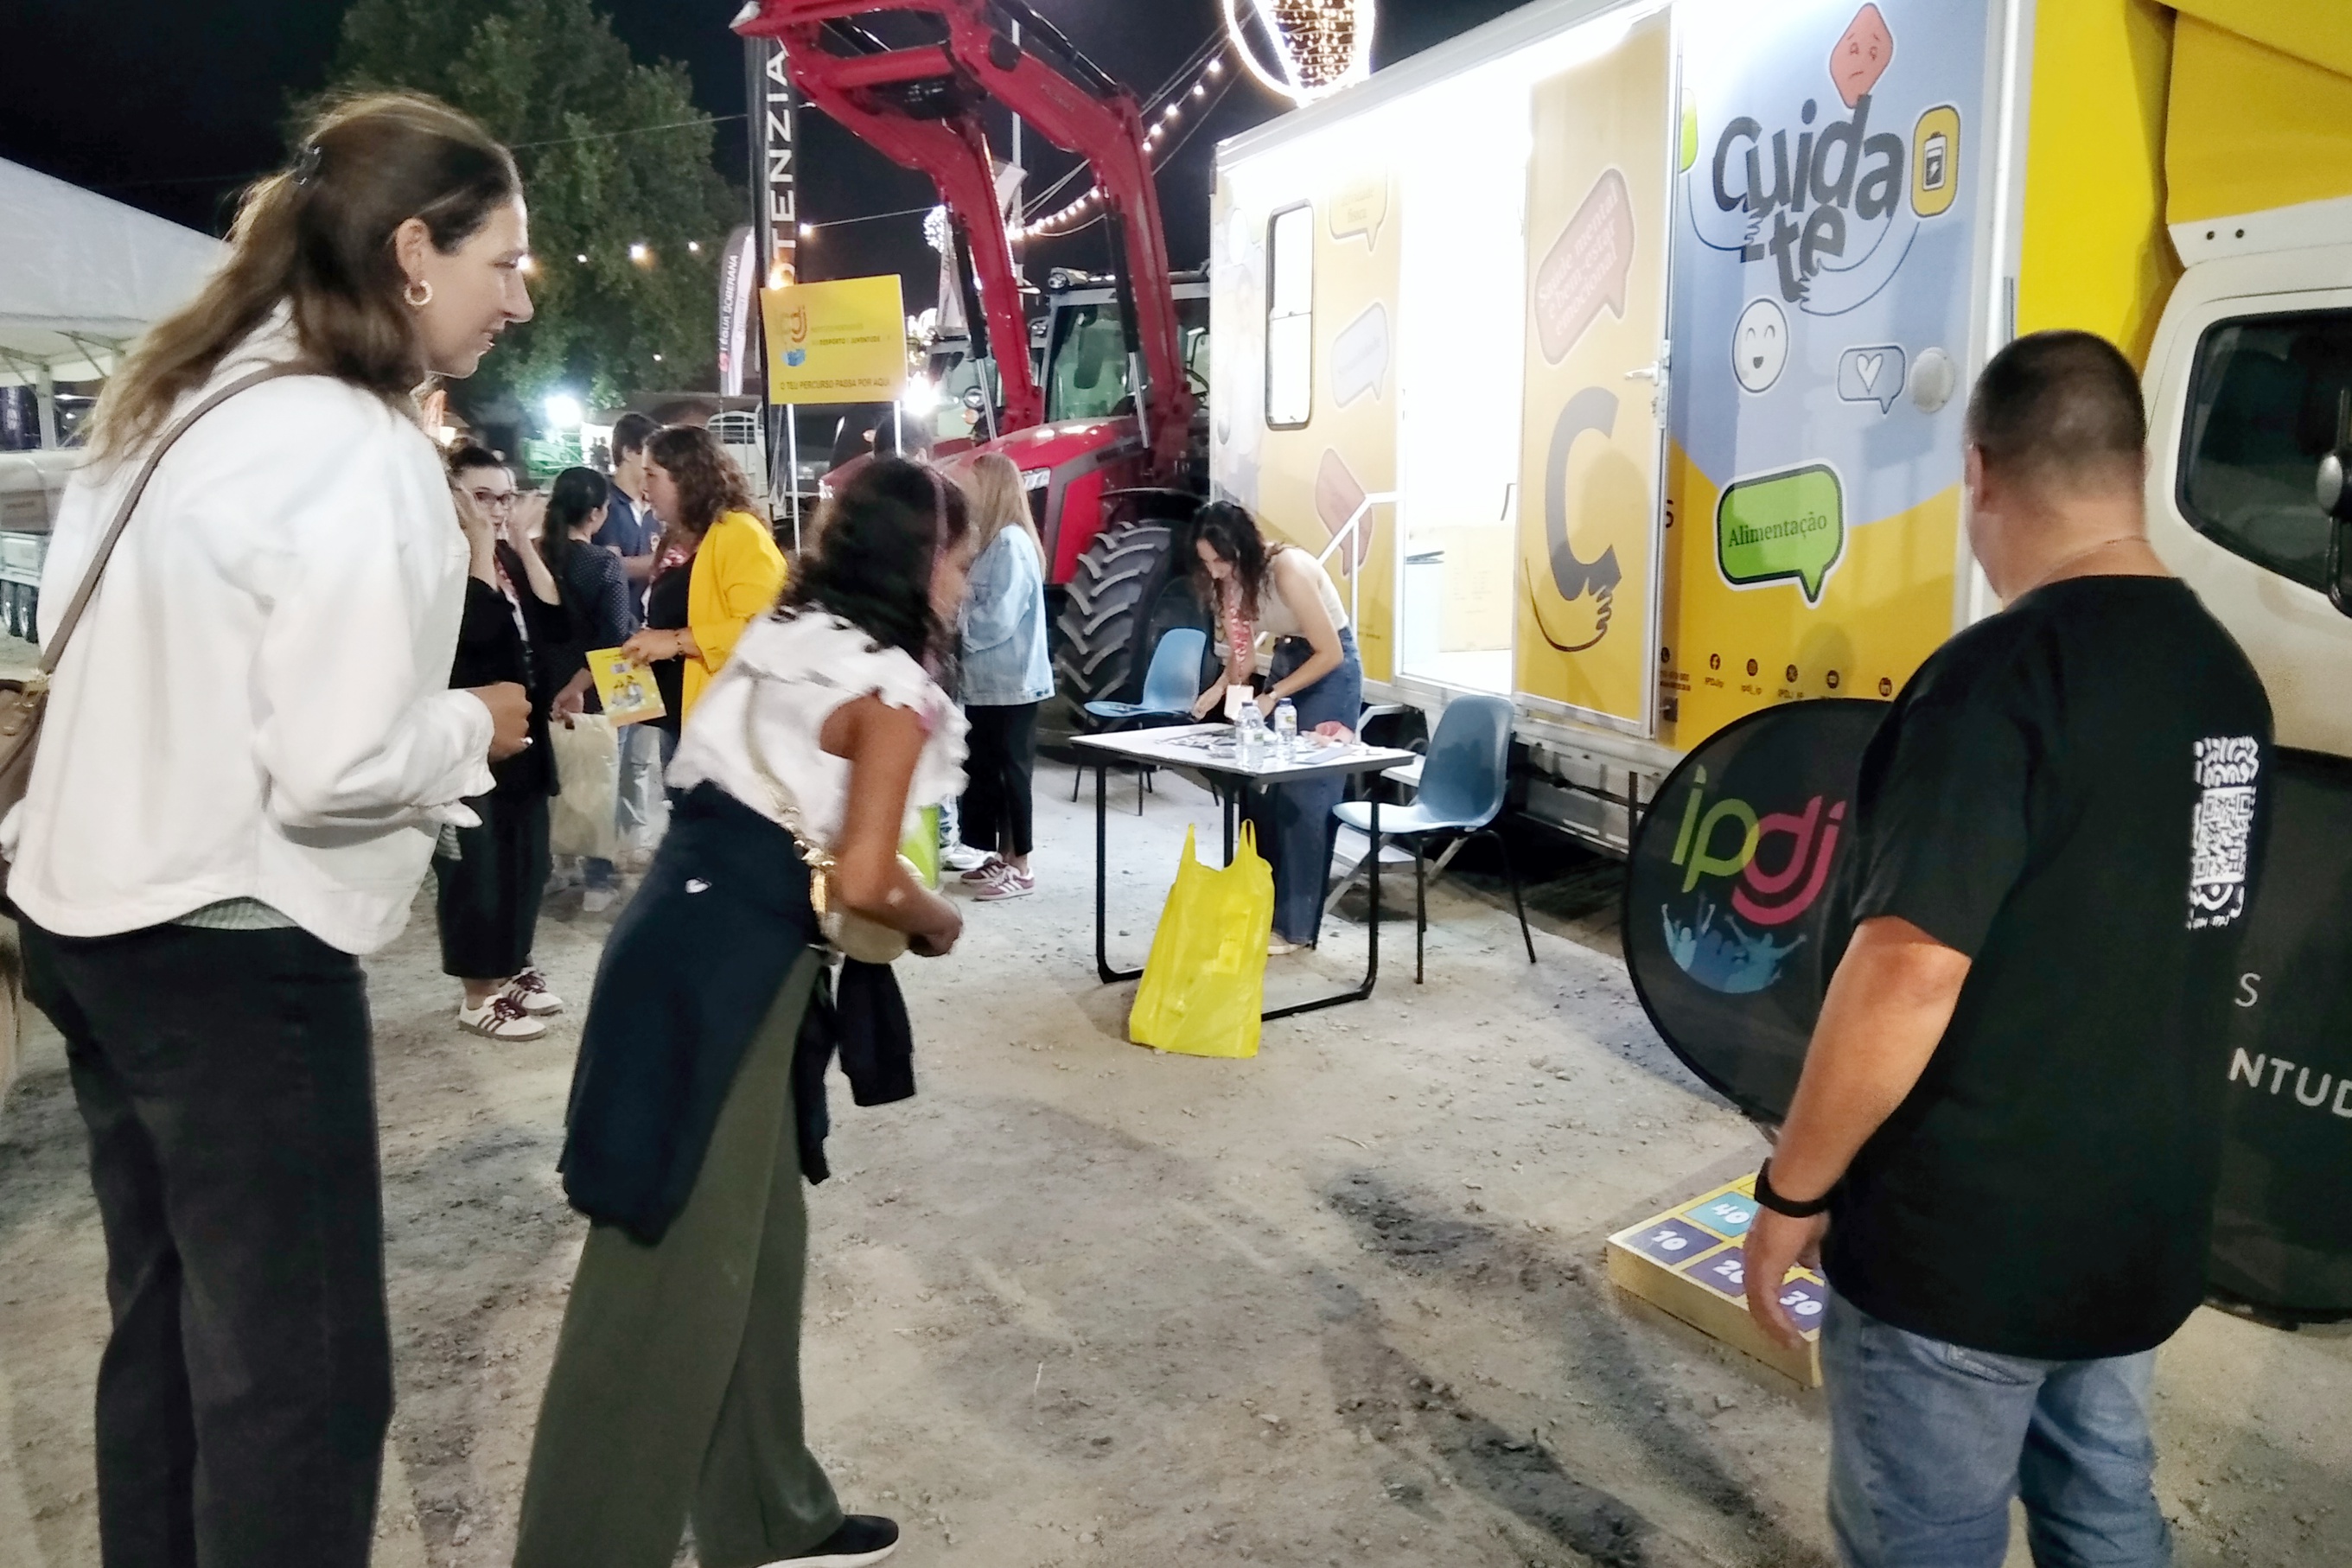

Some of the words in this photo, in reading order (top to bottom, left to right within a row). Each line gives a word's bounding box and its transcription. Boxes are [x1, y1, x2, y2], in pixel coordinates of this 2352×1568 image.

[1574, 182, 1618, 256] mental
[1556, 240, 1617, 335] emocional
[800, 379, 833, 390] PERCURSO
[835, 379, 857, 388] PASSA
[1729, 511, 1826, 547] Alimentação
[1671, 764, 1846, 925] ipdj
[1711, 1202, 1750, 1224] 40
[1651, 1230, 1688, 1251] 10
[1779, 1290, 1823, 1316] 30
